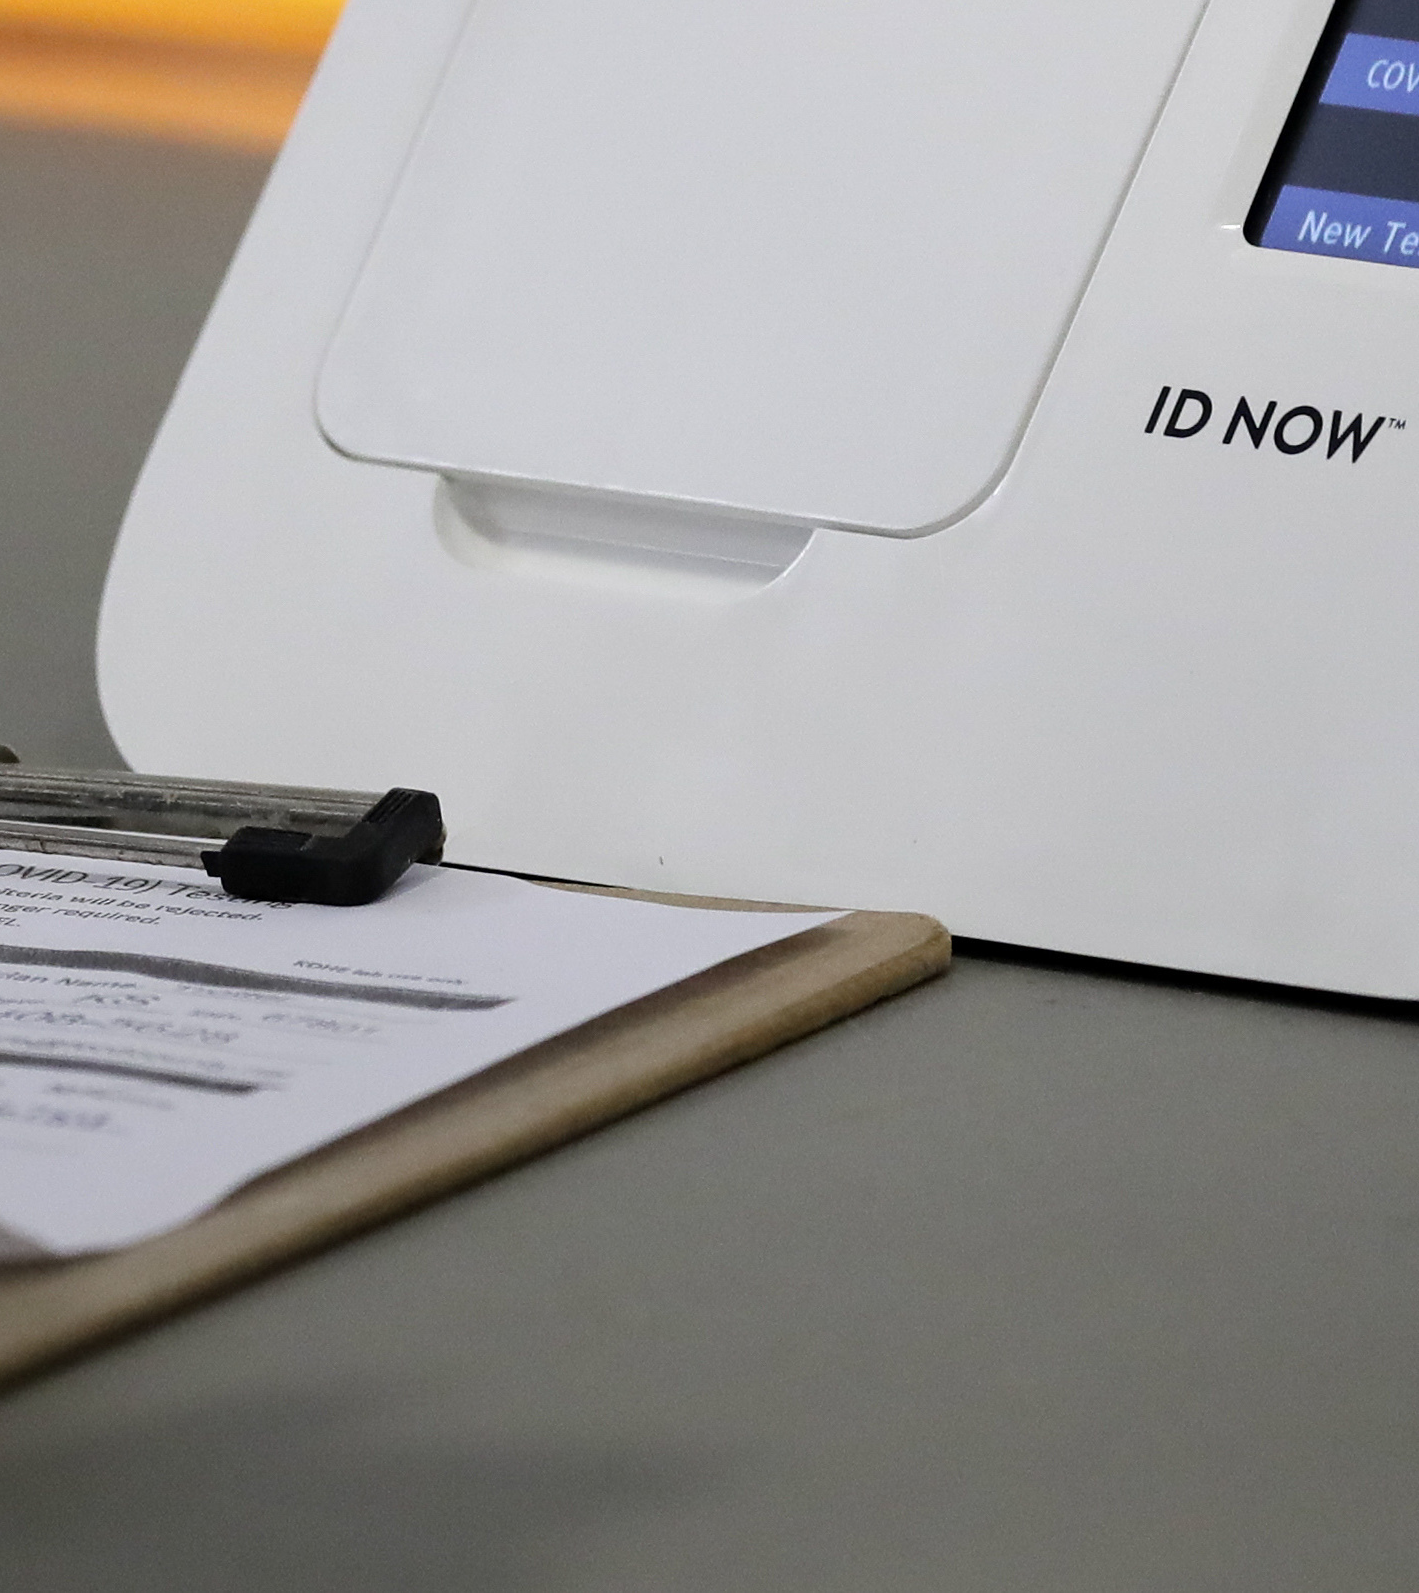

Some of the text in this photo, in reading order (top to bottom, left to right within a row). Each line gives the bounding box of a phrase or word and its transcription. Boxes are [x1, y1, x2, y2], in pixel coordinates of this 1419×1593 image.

[1297, 209, 1372, 248] New
[1144, 385, 1213, 439] ID
[51, 907, 161, 926] required.
[70, 894, 119, 907] will
[117, 898, 151, 909] be
[154, 902, 264, 922] rejected.
